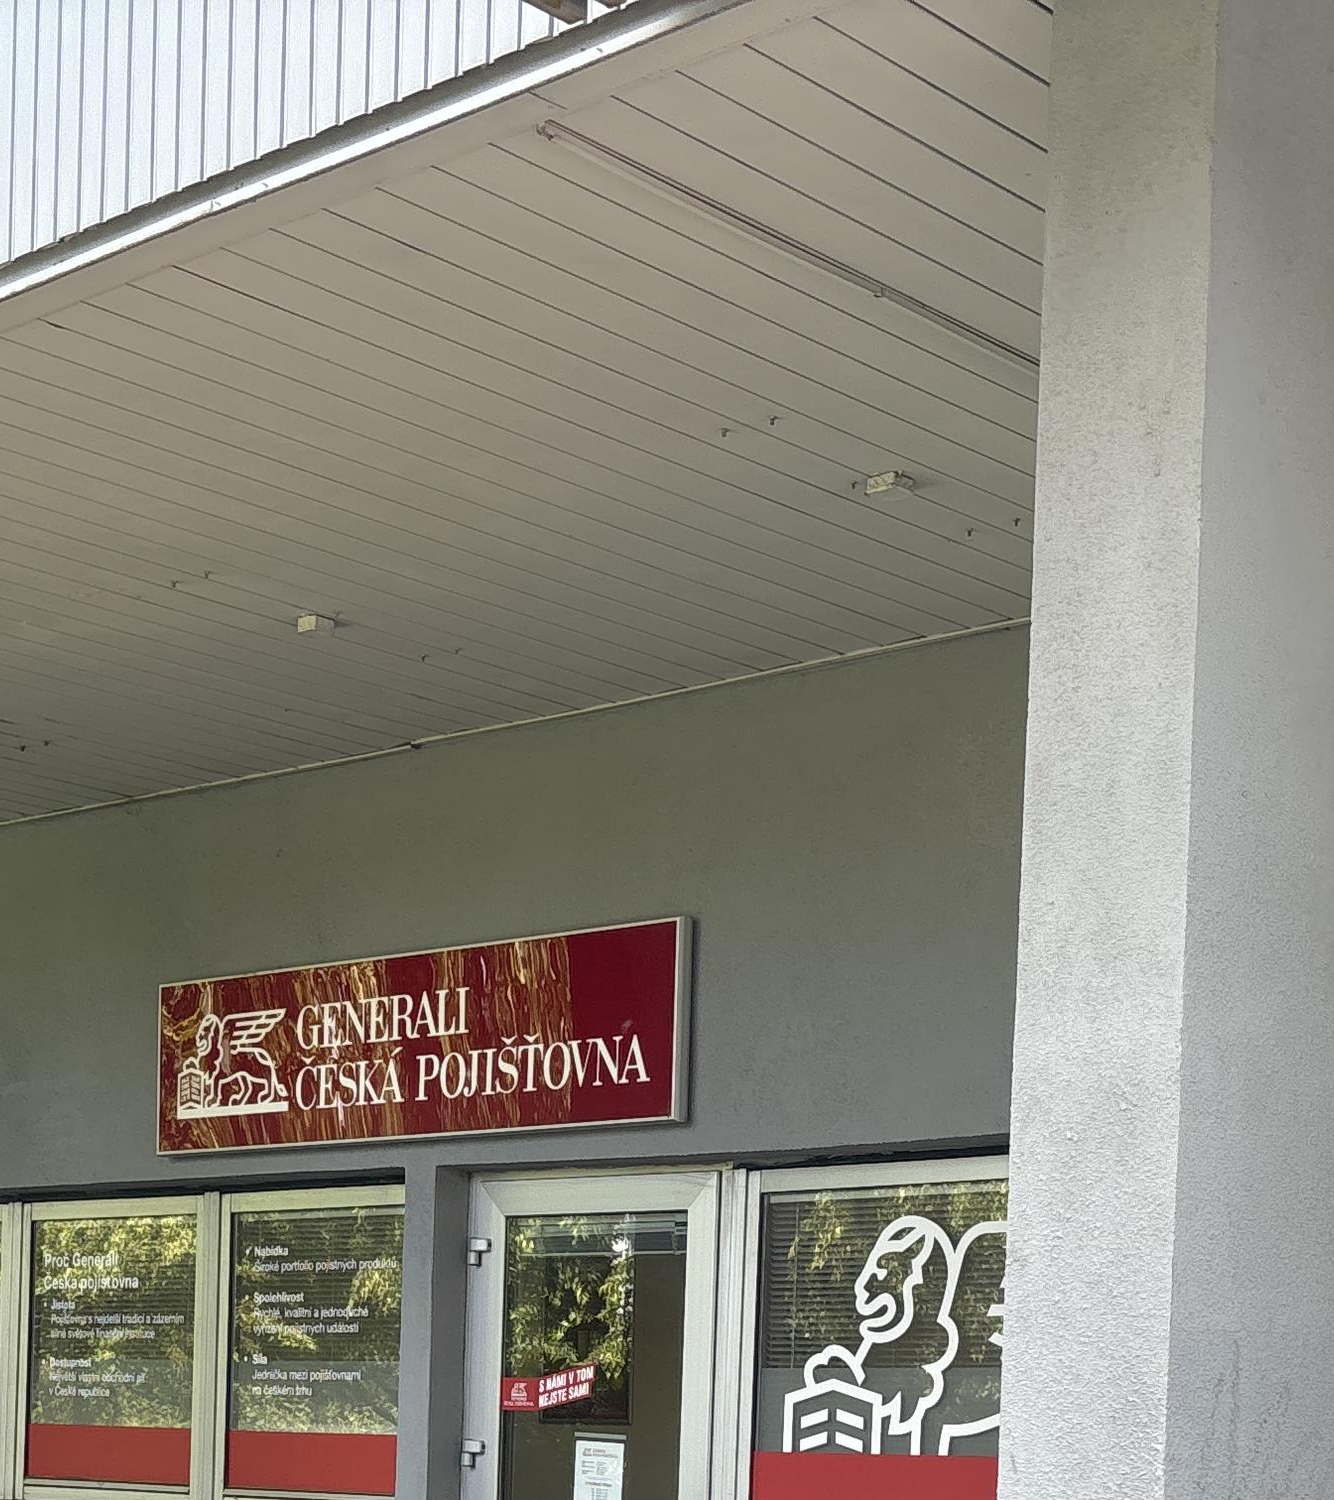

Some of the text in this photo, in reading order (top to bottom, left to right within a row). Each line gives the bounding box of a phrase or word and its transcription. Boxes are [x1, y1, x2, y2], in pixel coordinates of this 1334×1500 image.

[295, 985, 470, 1050] GENERALI
[294, 1034, 651, 1112] ČESKÁ POJIŠŤOVNA
[538, 1387, 568, 1408] NEJSTE
[568, 1382, 590, 1400] SAMI
[568, 1371, 575, 1385] V
[576, 1365, 595, 1382] TOM
